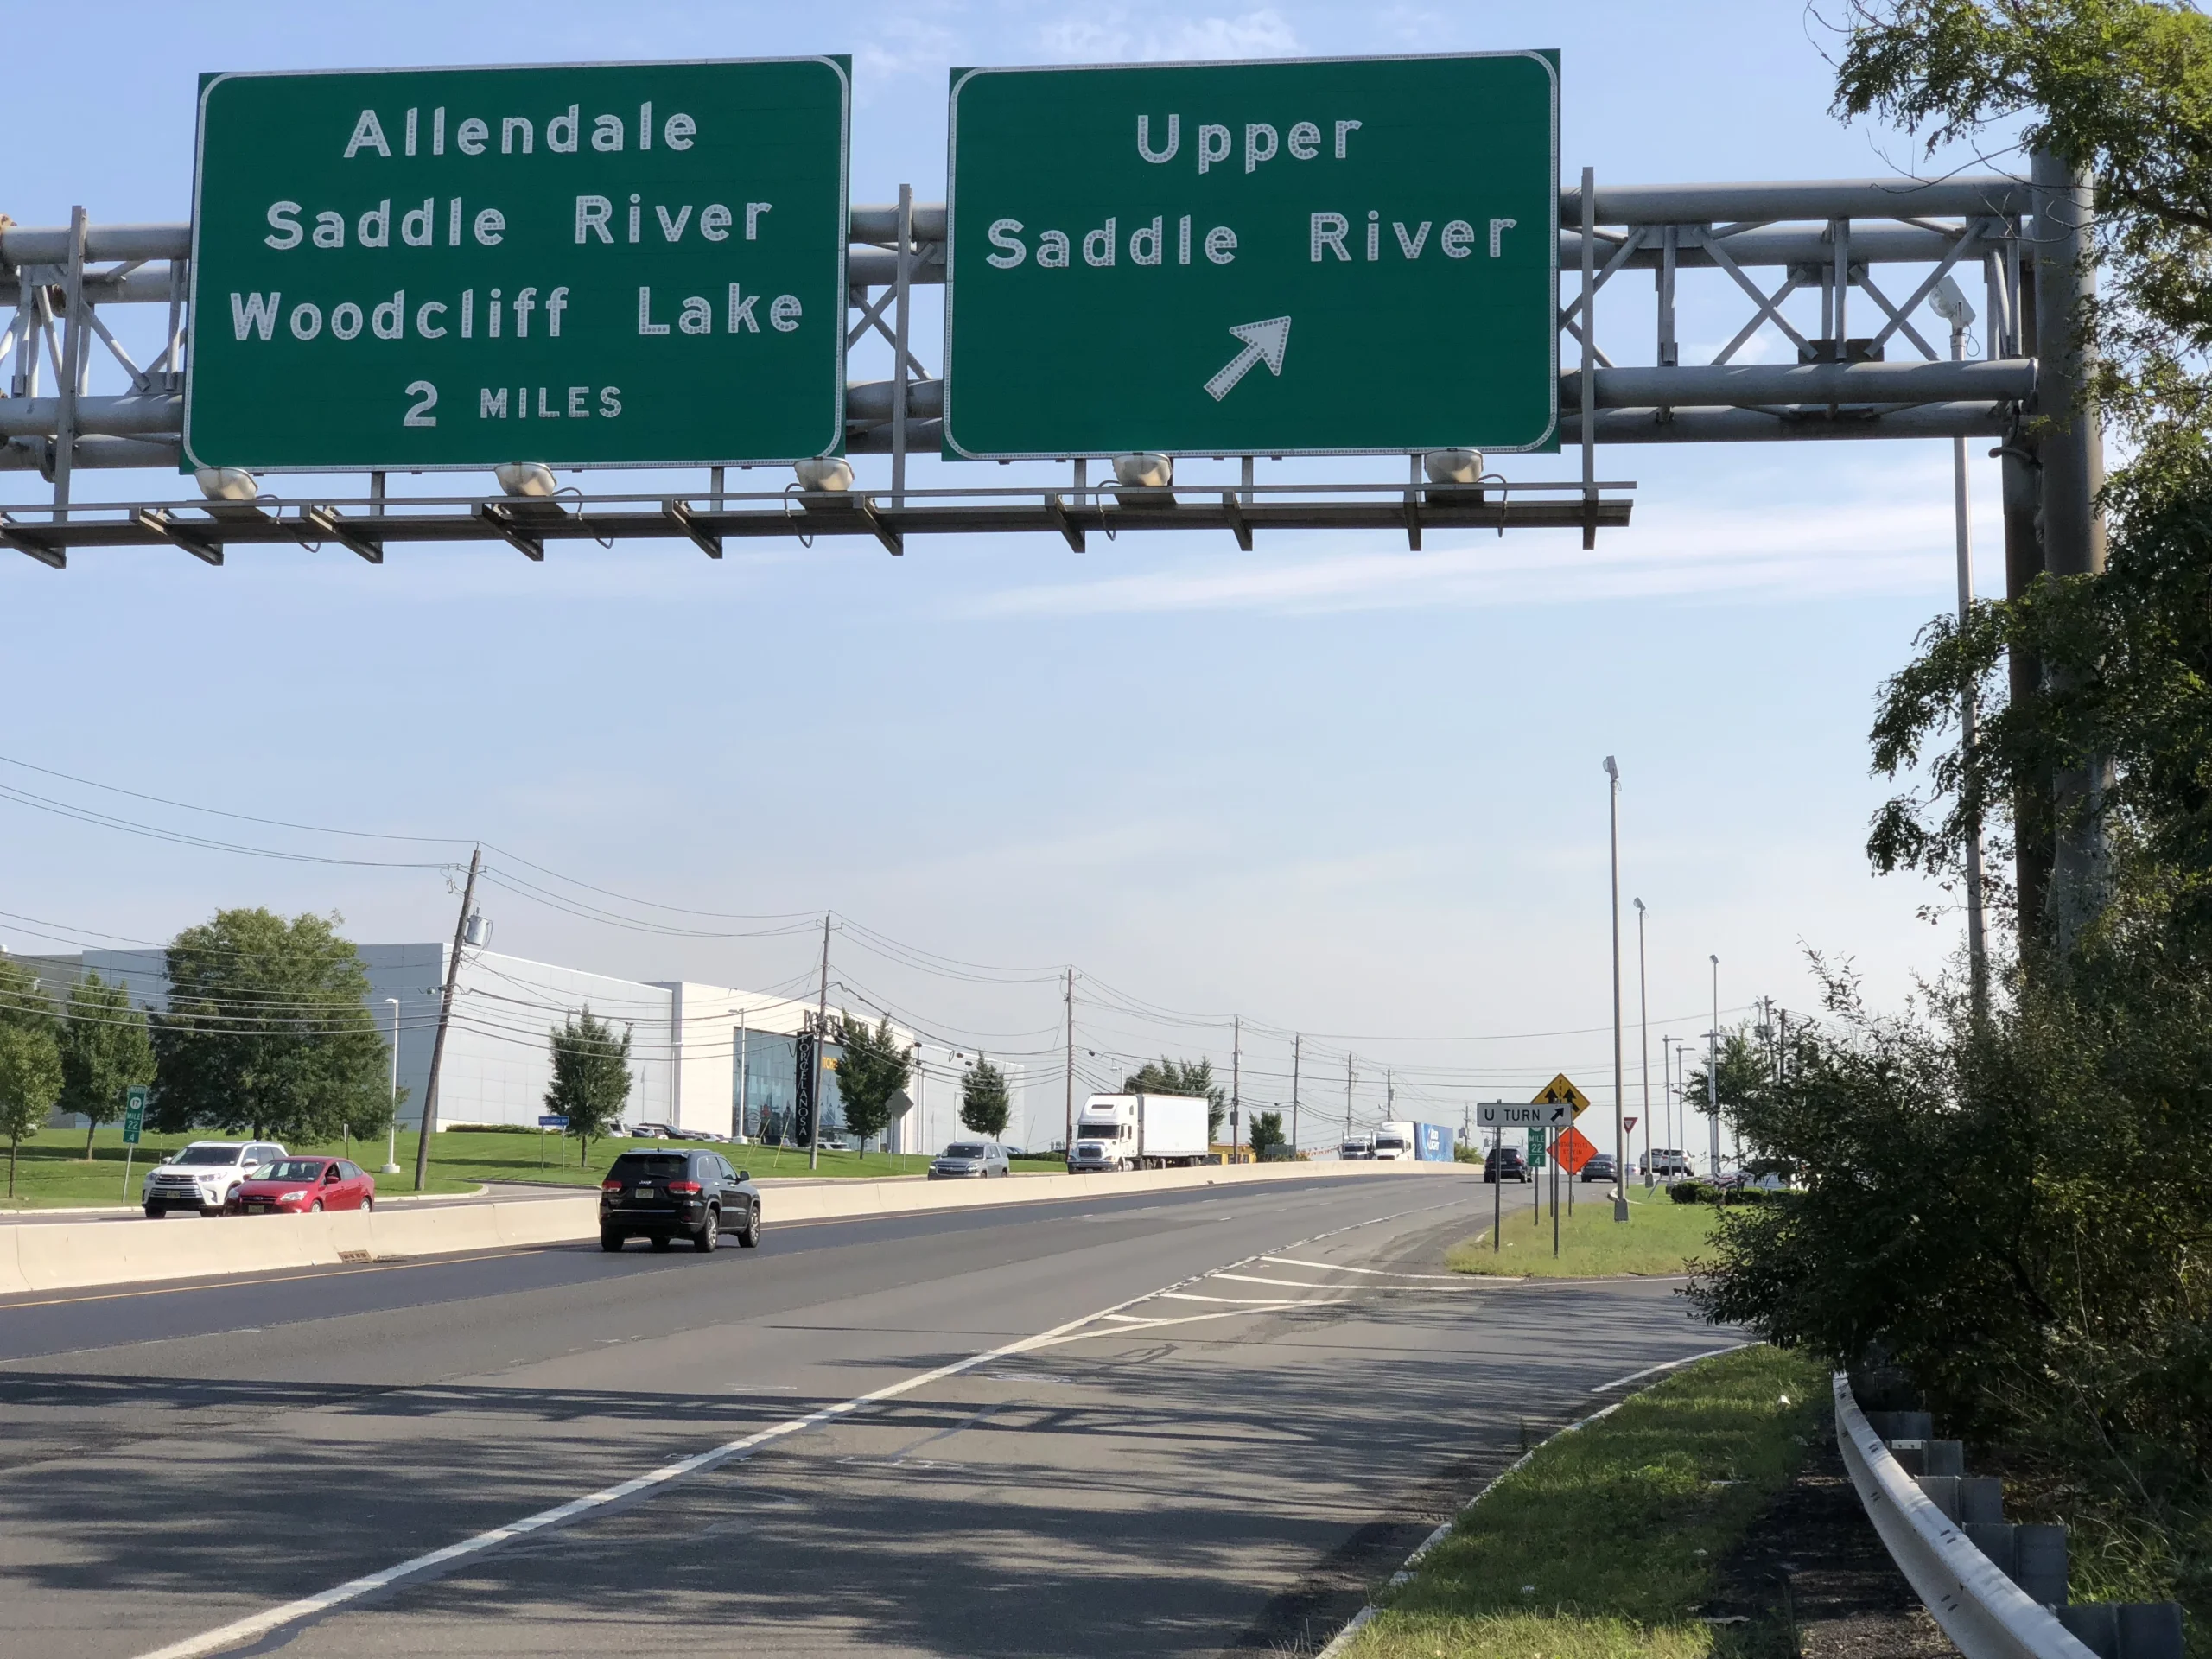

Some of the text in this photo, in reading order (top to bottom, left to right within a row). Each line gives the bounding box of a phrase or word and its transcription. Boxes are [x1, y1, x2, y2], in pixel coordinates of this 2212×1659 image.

[343, 101, 696, 158] Allendale
[1137, 114, 1363, 175] Upper
[264, 193, 772, 250] Saddle River
[986, 210, 1517, 269] Saddle River
[230, 283, 802, 340] Woodcliff Lake
[403, 380, 622, 427] 2 MILES
[798, 1034, 810, 1136] PORCELANOSA
[127, 1121, 138, 1129] 22
[1484, 1109, 1540, 1121] U TURN
[1531, 1144, 1542, 1153] 22
